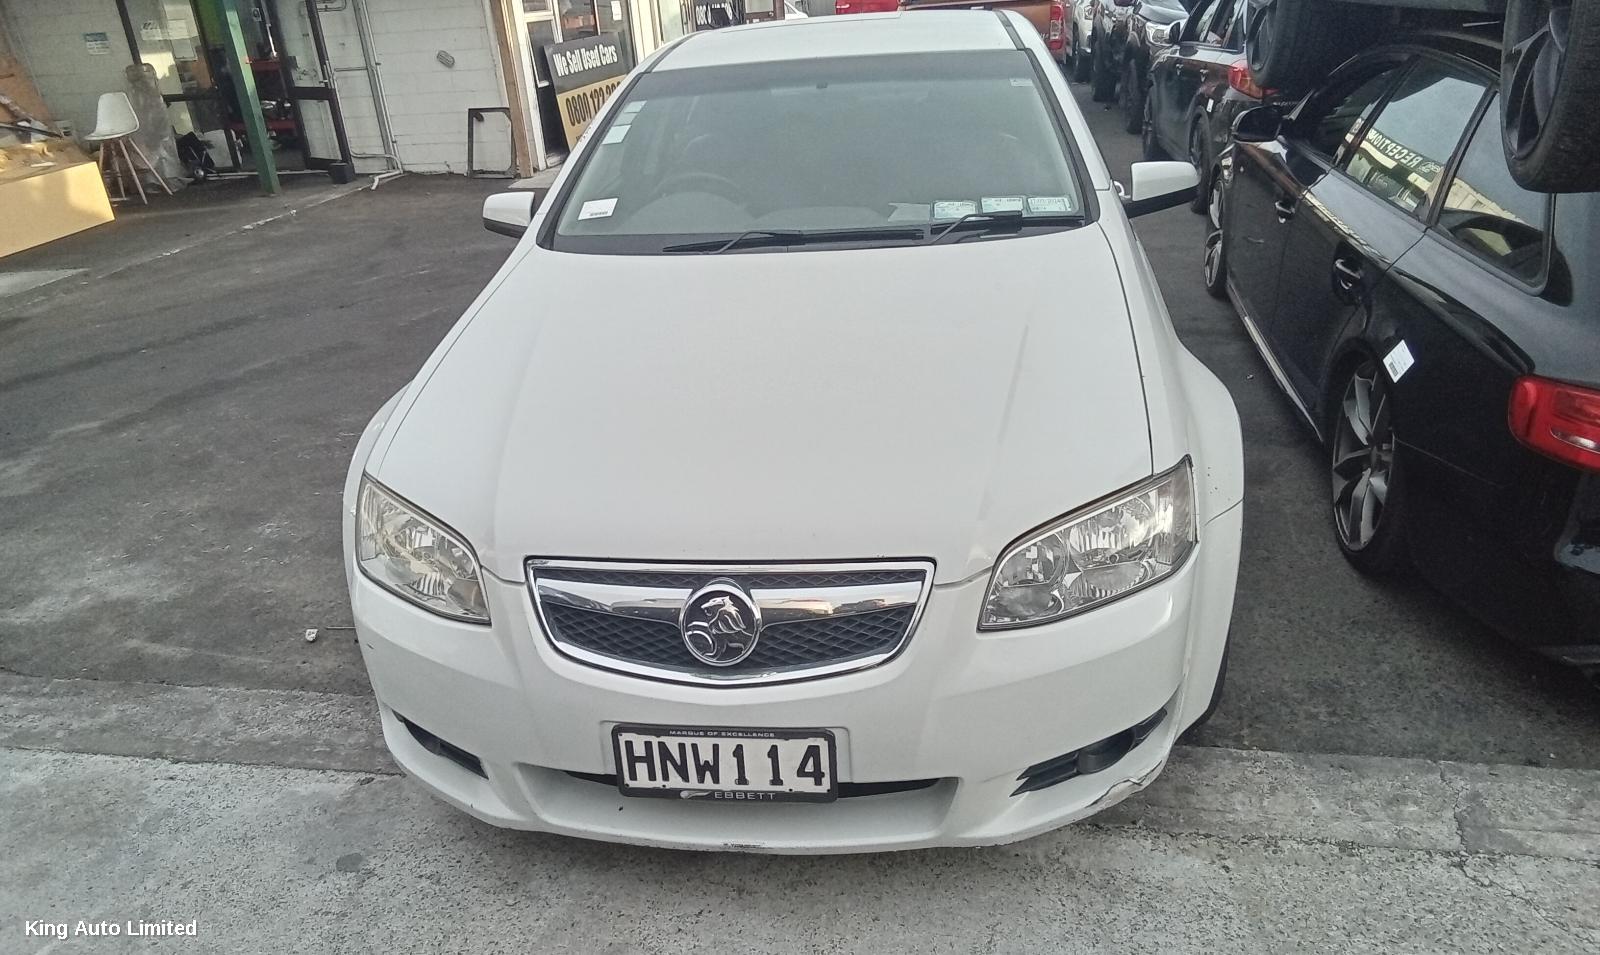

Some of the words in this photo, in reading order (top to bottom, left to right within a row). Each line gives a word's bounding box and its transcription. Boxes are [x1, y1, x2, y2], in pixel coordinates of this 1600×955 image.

[553, 53, 569, 77] We
[566, 48, 584, 74] Sell
[580, 44, 601, 70] Used
[598, 43, 618, 66] Cars
[565, 91, 592, 127] 0800
[624, 740, 826, 786] HNW114
[714, 791, 776, 800] EBBETT
